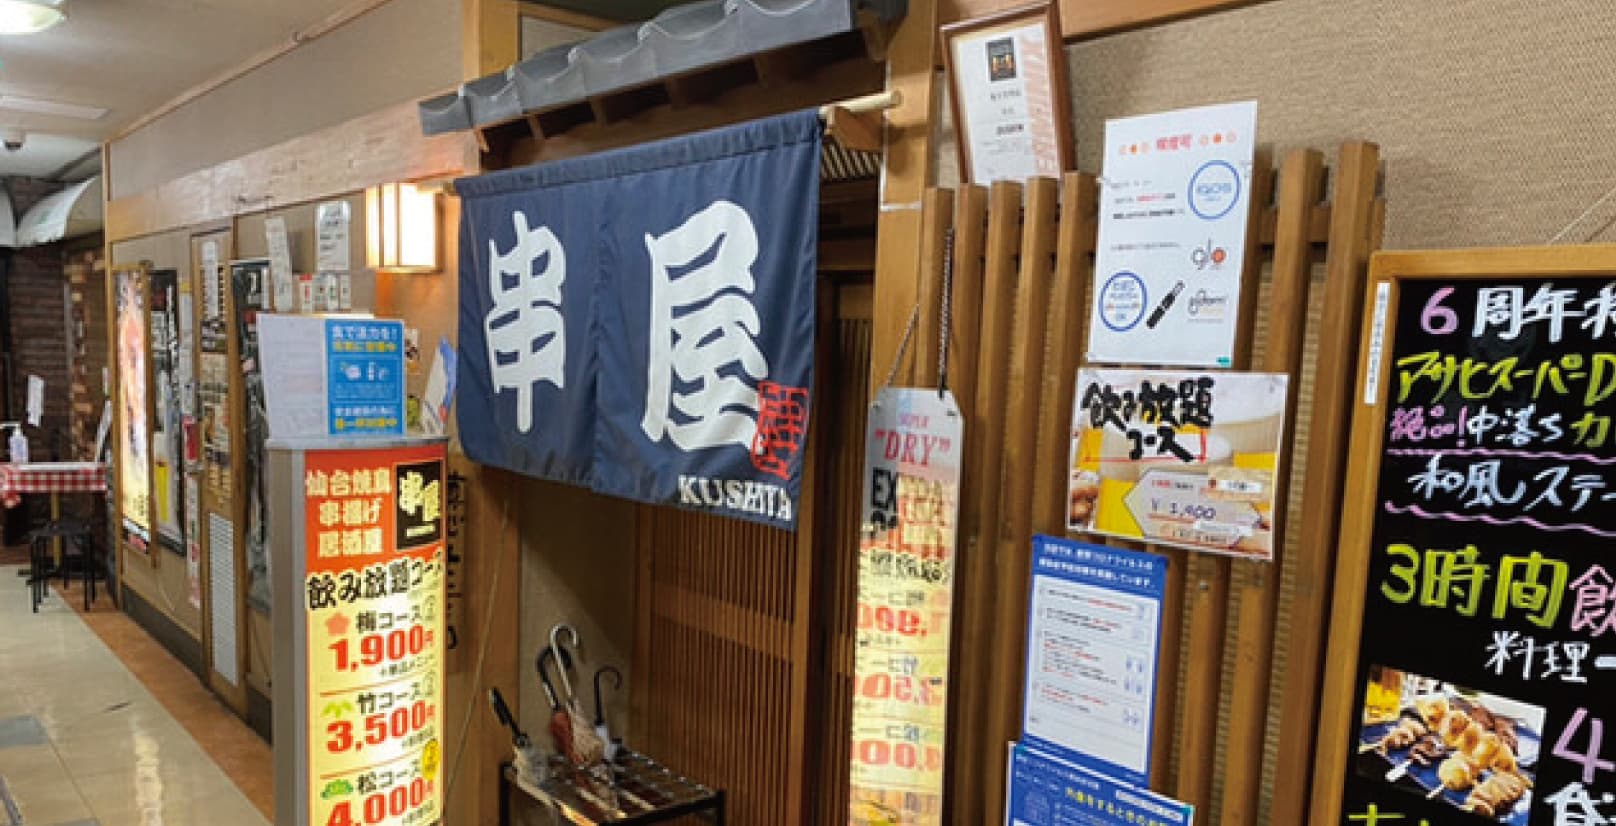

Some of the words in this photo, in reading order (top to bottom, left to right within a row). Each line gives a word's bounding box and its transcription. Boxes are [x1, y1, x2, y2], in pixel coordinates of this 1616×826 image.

[484, 199, 770, 453] 串屋
[1081, 376, 1215, 432] 飲み放題
[1126, 425, 1195, 463] コース
[356, 682, 421, 714] 竹コース
